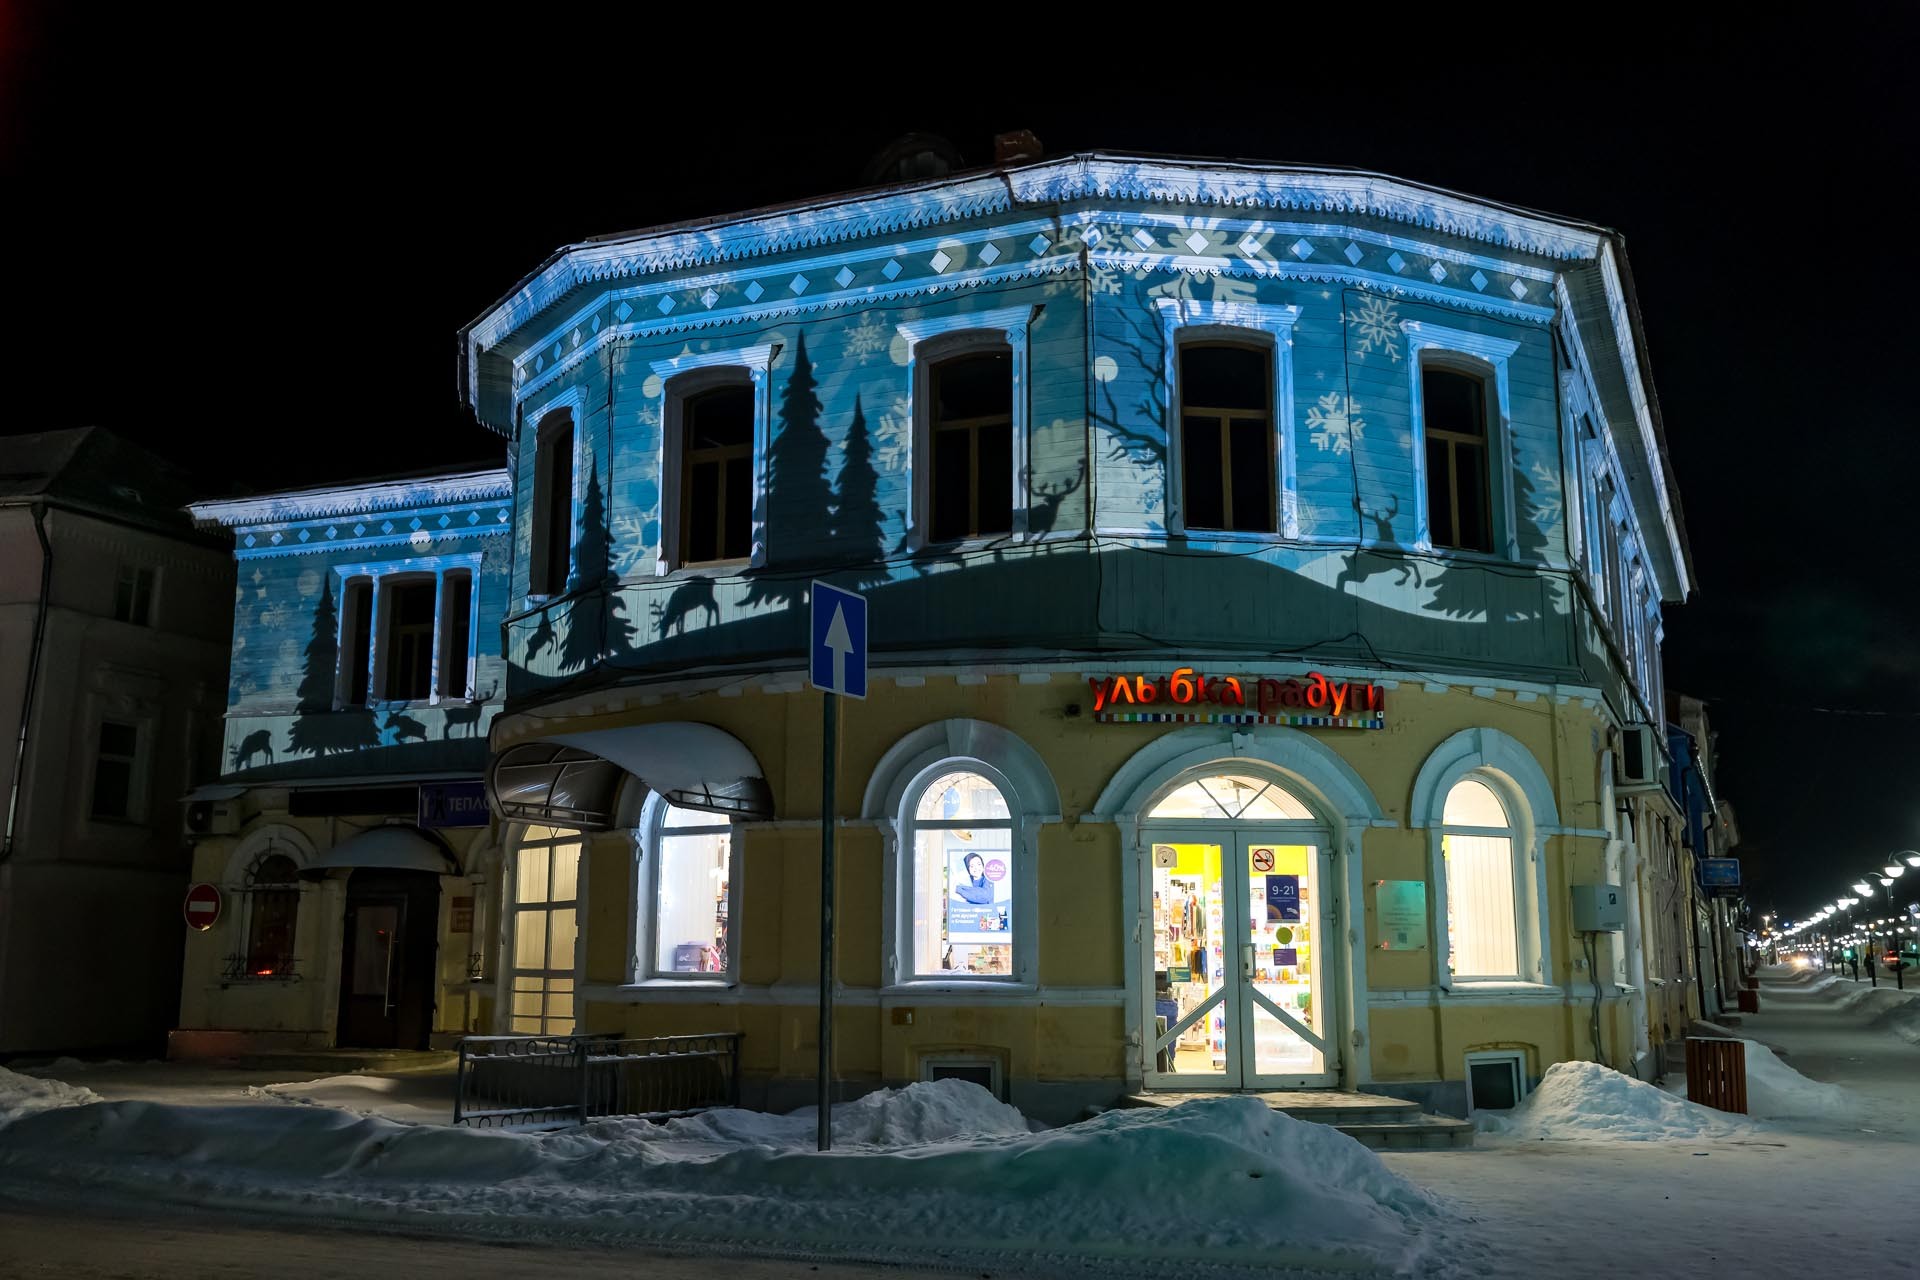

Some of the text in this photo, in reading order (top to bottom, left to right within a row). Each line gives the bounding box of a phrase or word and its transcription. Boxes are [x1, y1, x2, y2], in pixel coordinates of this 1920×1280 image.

[1089, 667, 1385, 717] улыбка радуги
[1271, 885, 1294, 895] 9-21
